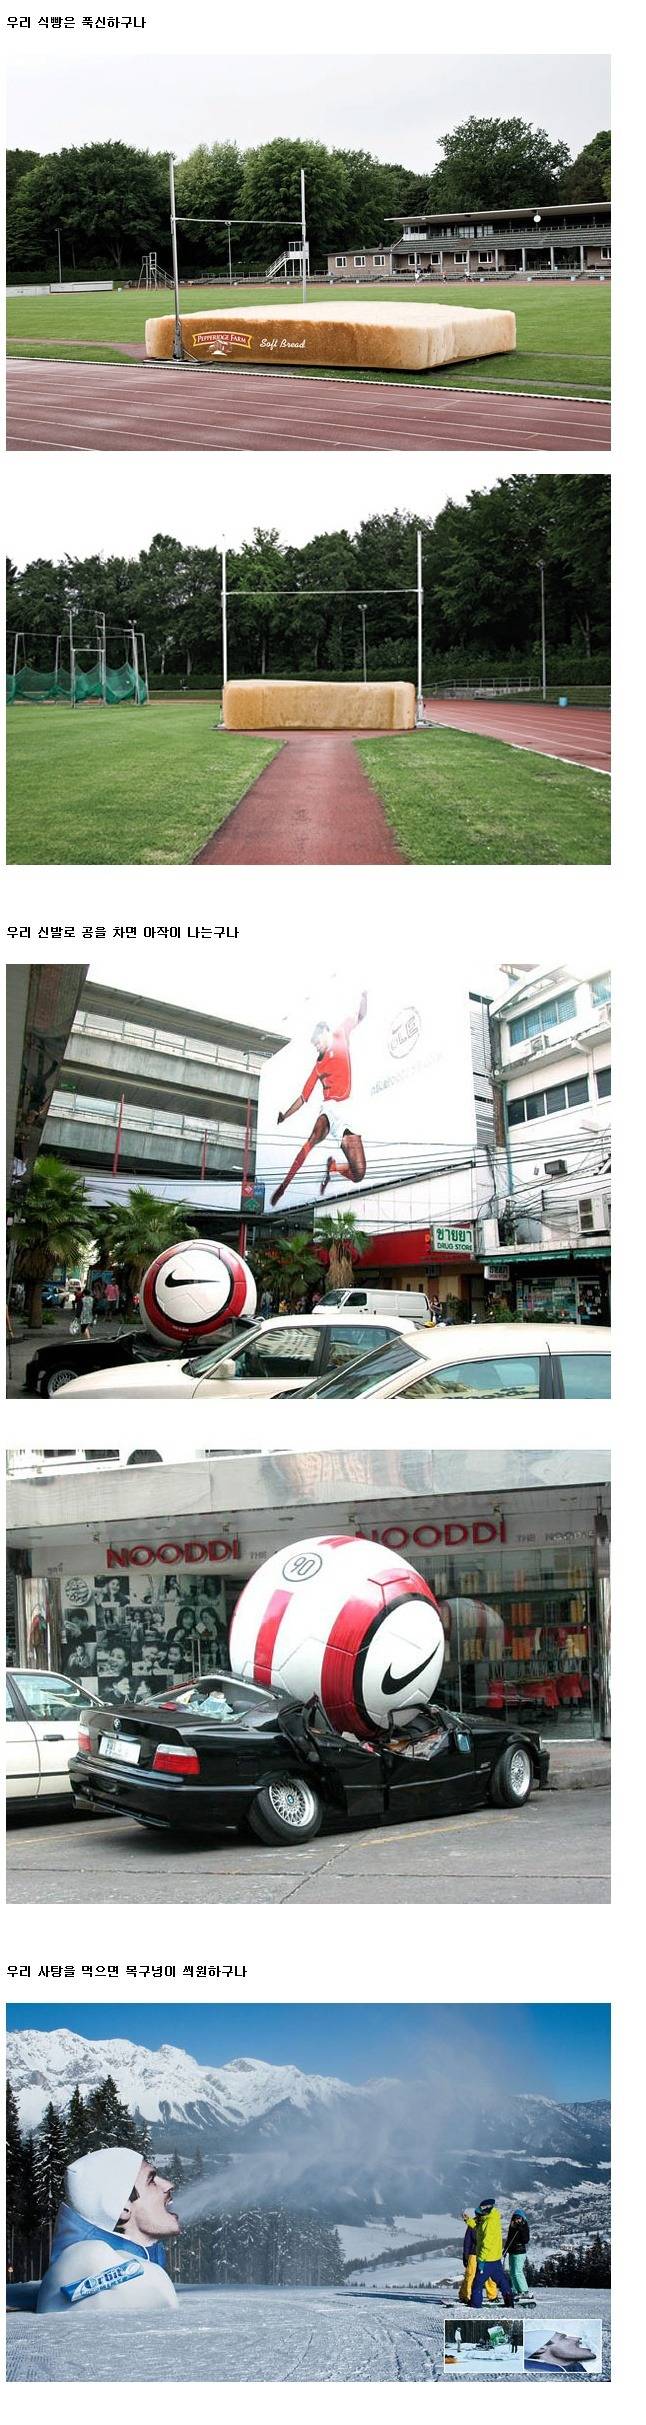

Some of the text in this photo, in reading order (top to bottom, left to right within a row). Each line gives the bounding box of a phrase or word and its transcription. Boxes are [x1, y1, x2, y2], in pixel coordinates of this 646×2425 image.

[230, 335, 247, 343] FARM
[260, 338, 306, 350] Soft Bread
[436, 1228, 472, 1242] ขายยา
[106, 1537, 239, 1569] NOODDI
[291, 1556, 316, 1576] 90
[84, 2267, 122, 2289] Orbit
